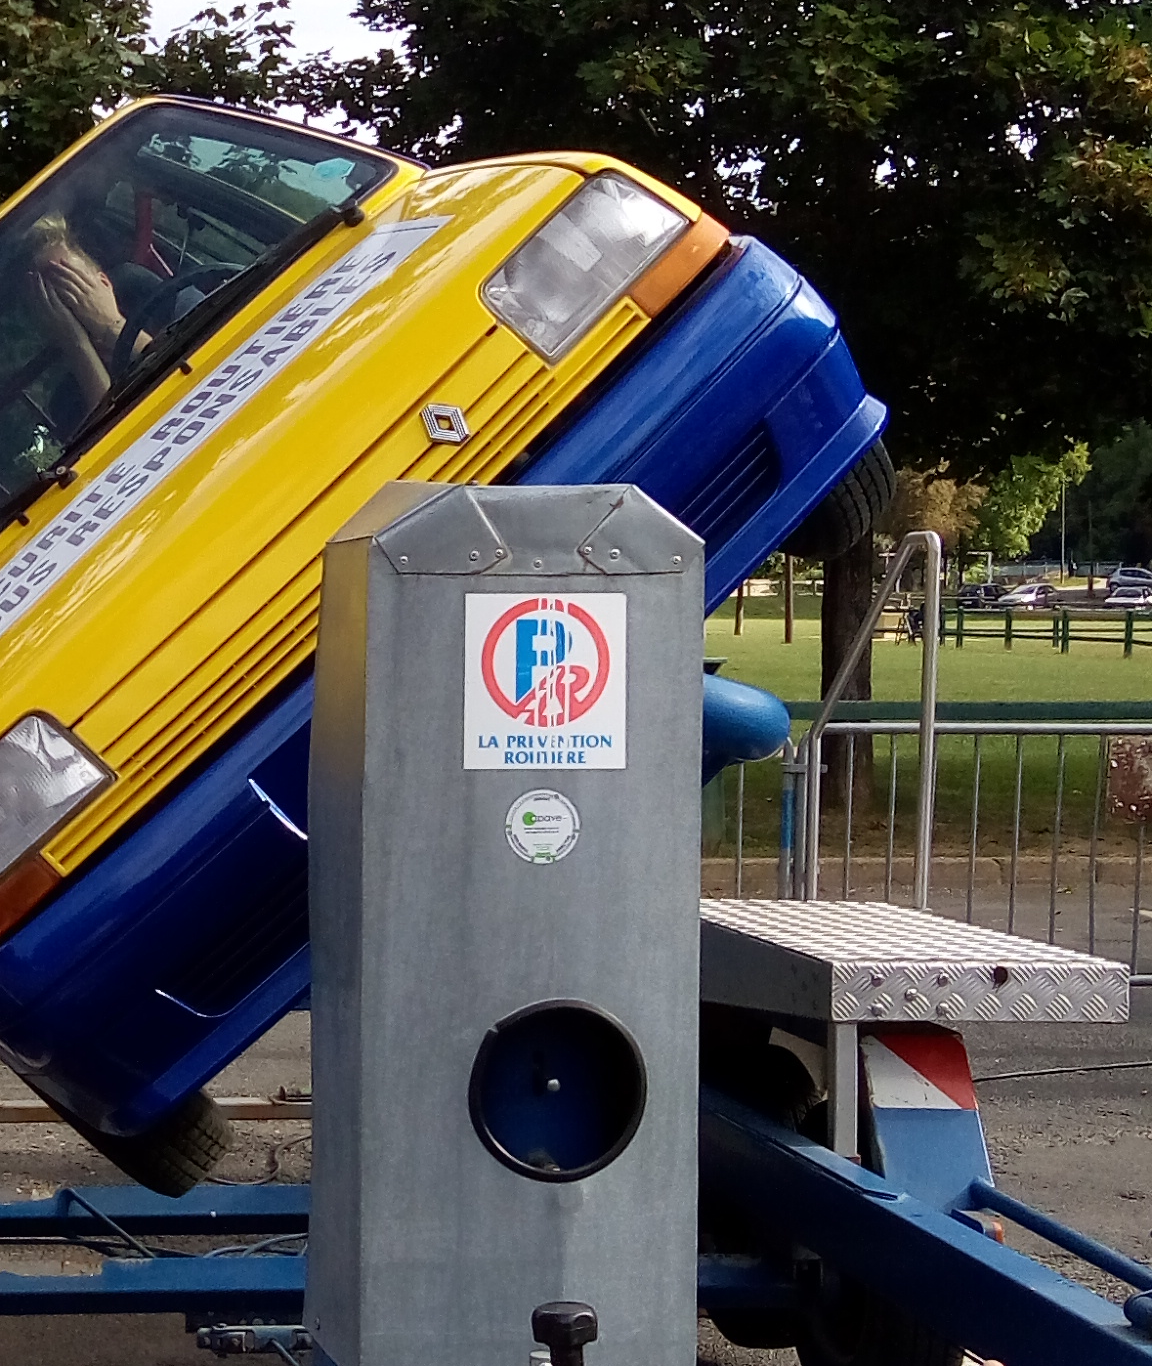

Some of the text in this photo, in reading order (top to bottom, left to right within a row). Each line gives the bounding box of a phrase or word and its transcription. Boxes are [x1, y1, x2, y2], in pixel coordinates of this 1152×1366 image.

[66, 251, 397, 547] RESPONSABLES
[150, 254, 369, 441] ROUTIERE
[478, 735, 498, 748] LA
